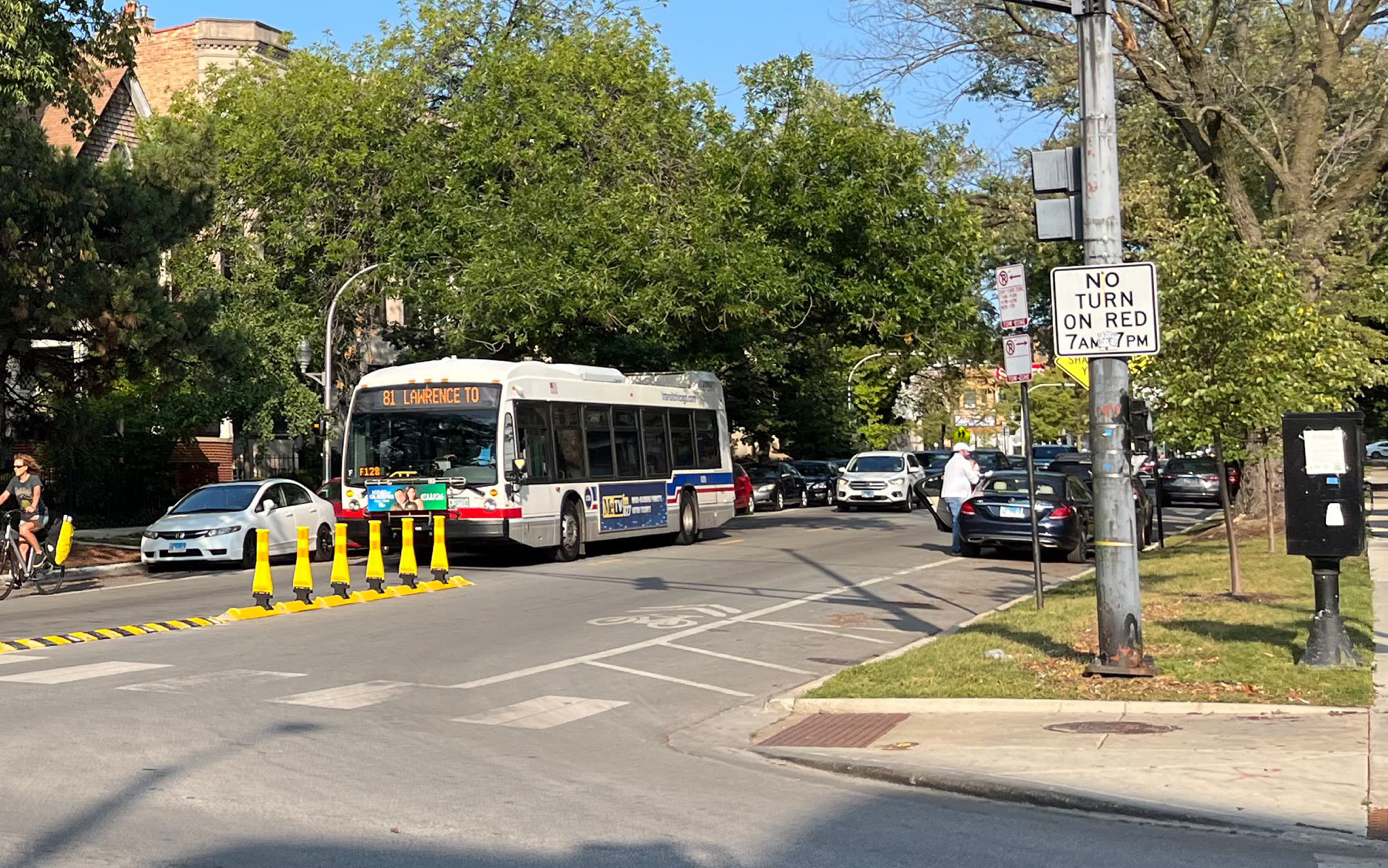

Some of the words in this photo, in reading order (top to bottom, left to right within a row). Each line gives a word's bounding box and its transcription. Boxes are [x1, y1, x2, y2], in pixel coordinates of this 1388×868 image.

[1085, 271, 1120, 289] NO
[1074, 291, 1134, 310] TURN
[1064, 313, 1092, 330] ON
[1105, 310, 1148, 329] RED
[383, 390, 396, 406] 81
[403, 387, 461, 405] LAWRENCE
[464, 386, 480, 404] TO
[359, 466, 381, 477] F128
